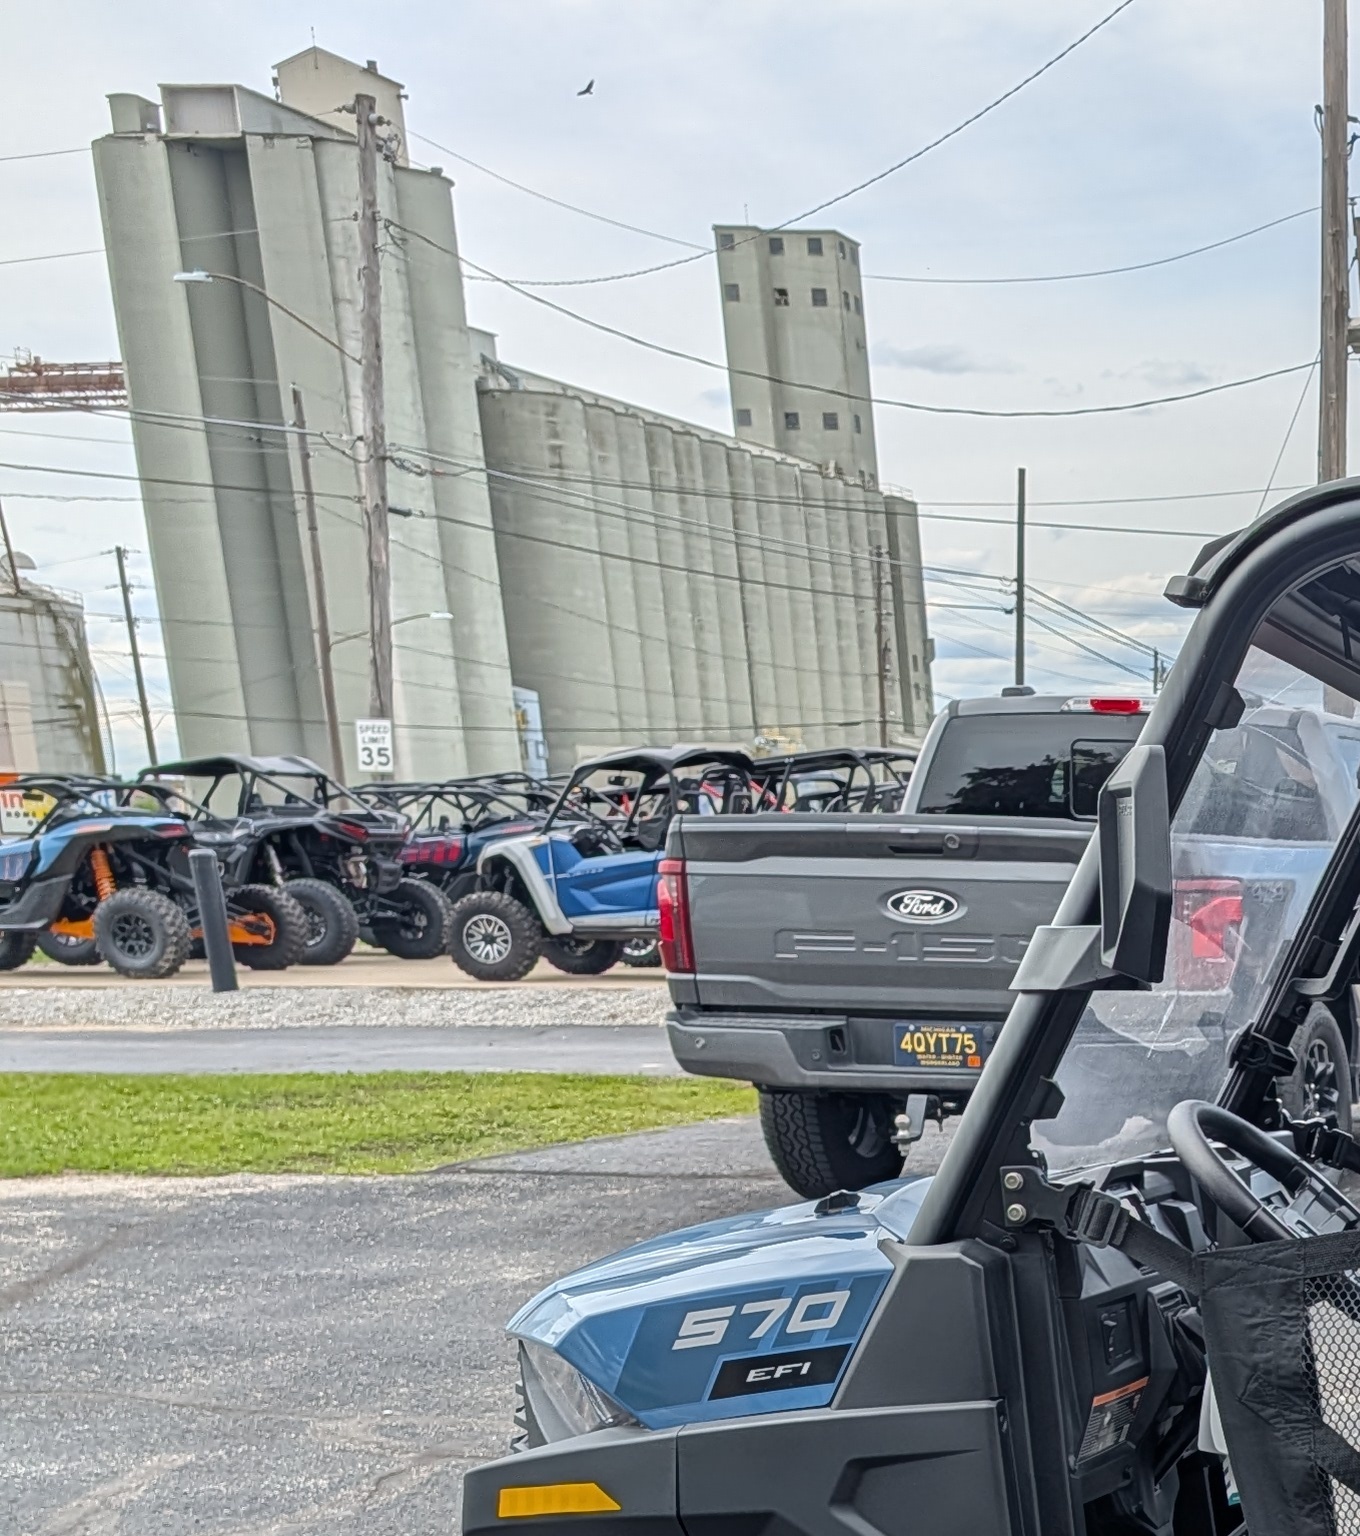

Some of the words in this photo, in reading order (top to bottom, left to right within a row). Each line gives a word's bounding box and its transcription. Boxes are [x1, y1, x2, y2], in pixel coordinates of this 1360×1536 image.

[359, 724, 390, 734] SPEED
[361, 736, 386, 744] LIMIT
[361, 746, 391, 767] 35
[899, 894, 945, 916] Ford
[900, 1032, 977, 1054] 4QYT75
[671, 1290, 851, 1350] 570
[746, 1362, 812, 1383] EFI
